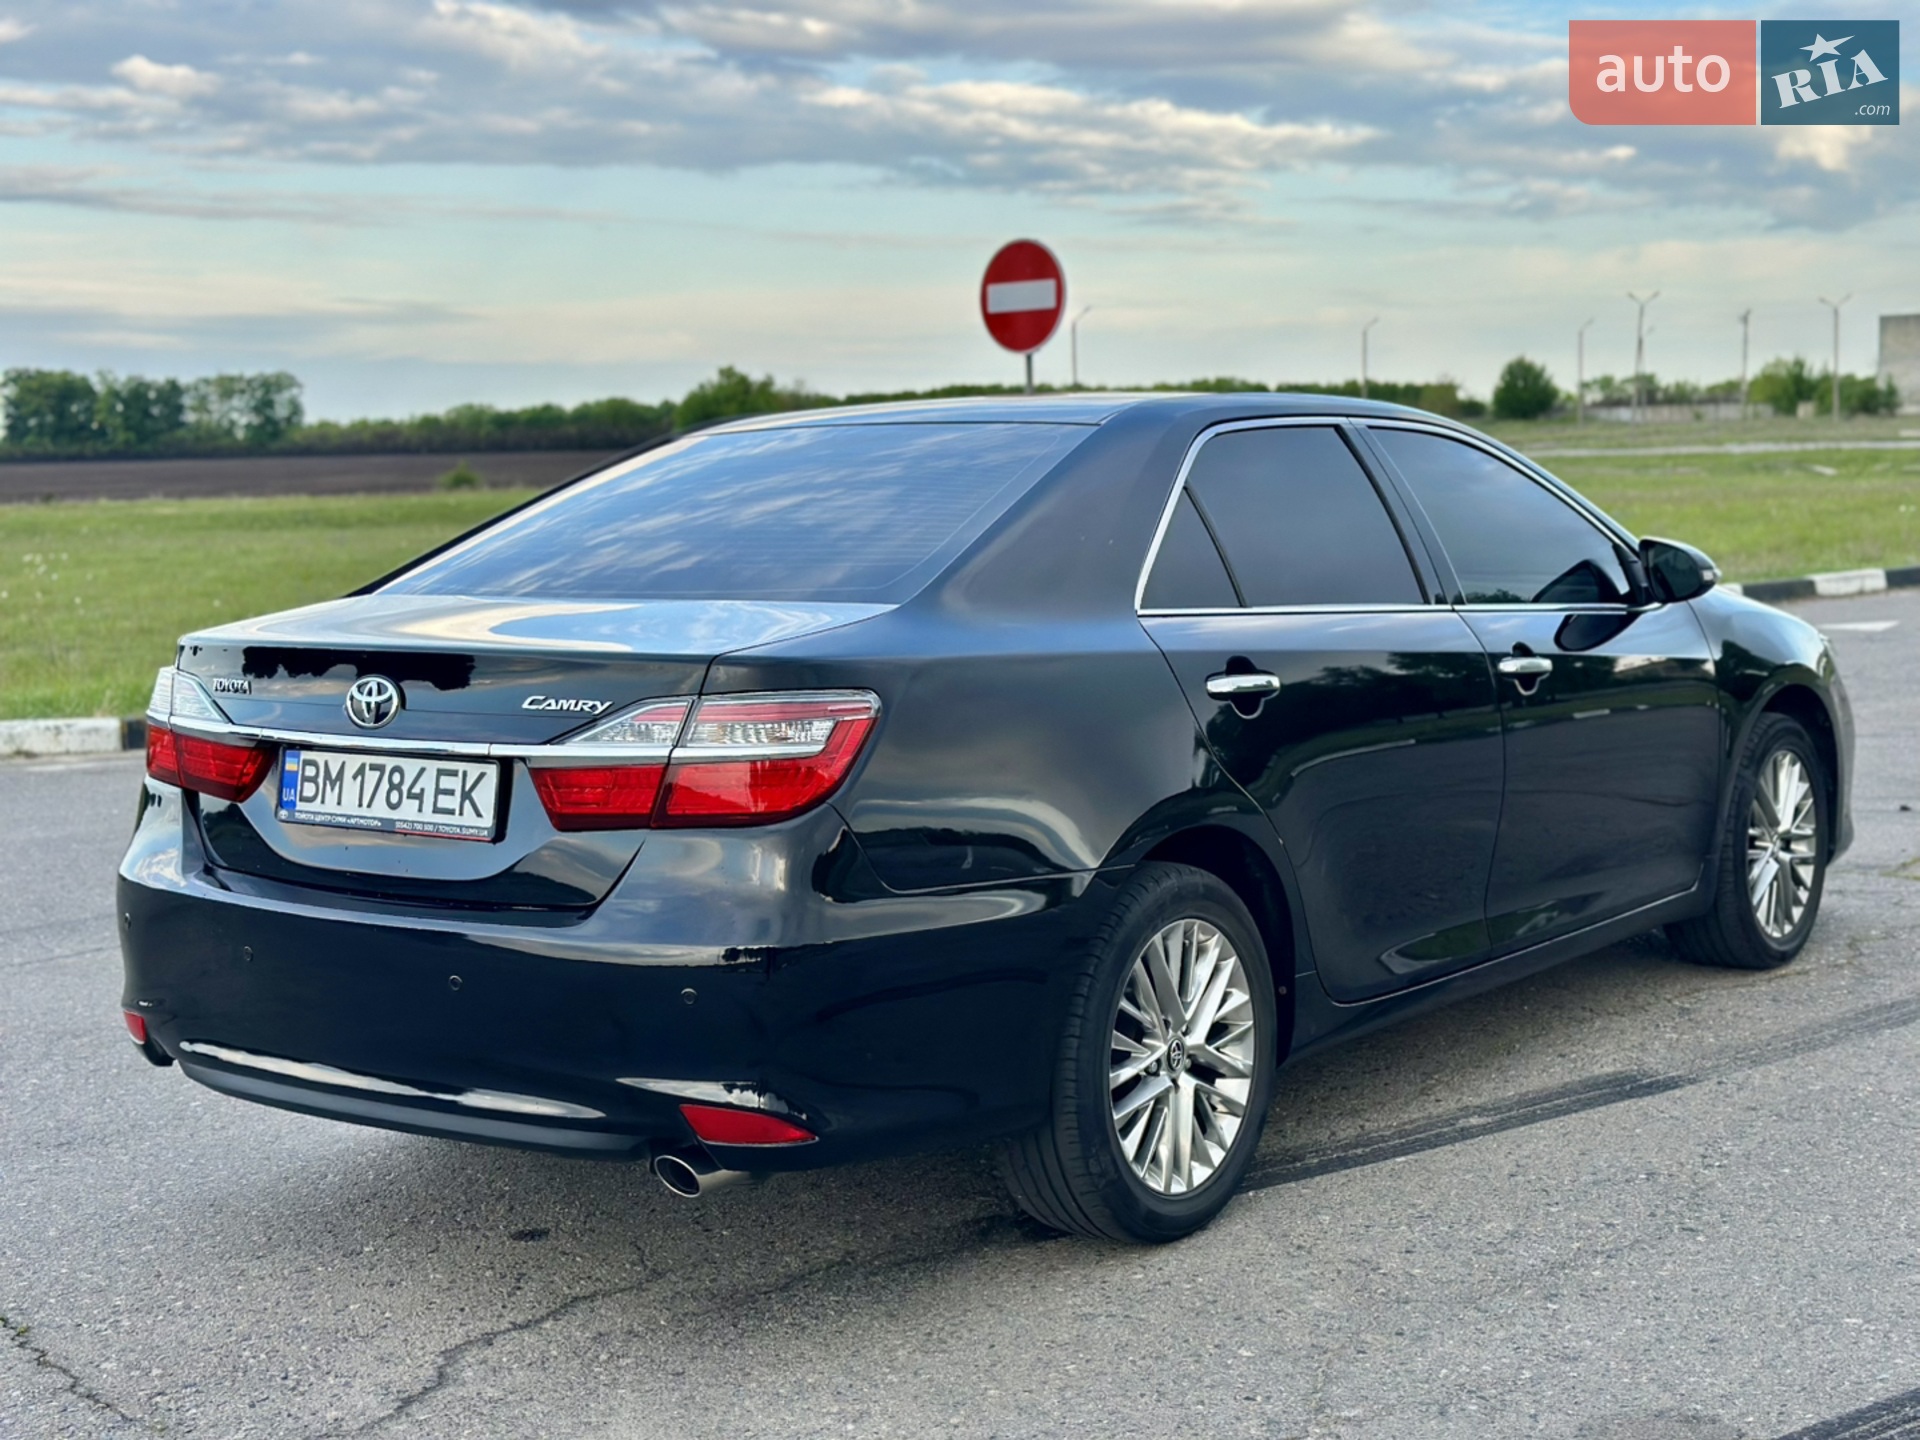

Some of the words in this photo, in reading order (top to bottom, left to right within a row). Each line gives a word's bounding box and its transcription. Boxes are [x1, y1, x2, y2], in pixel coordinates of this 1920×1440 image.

[213, 678, 251, 695] TOYOTA
[521, 695, 614, 715] CAMRY
[282, 788, 296, 803] UA
